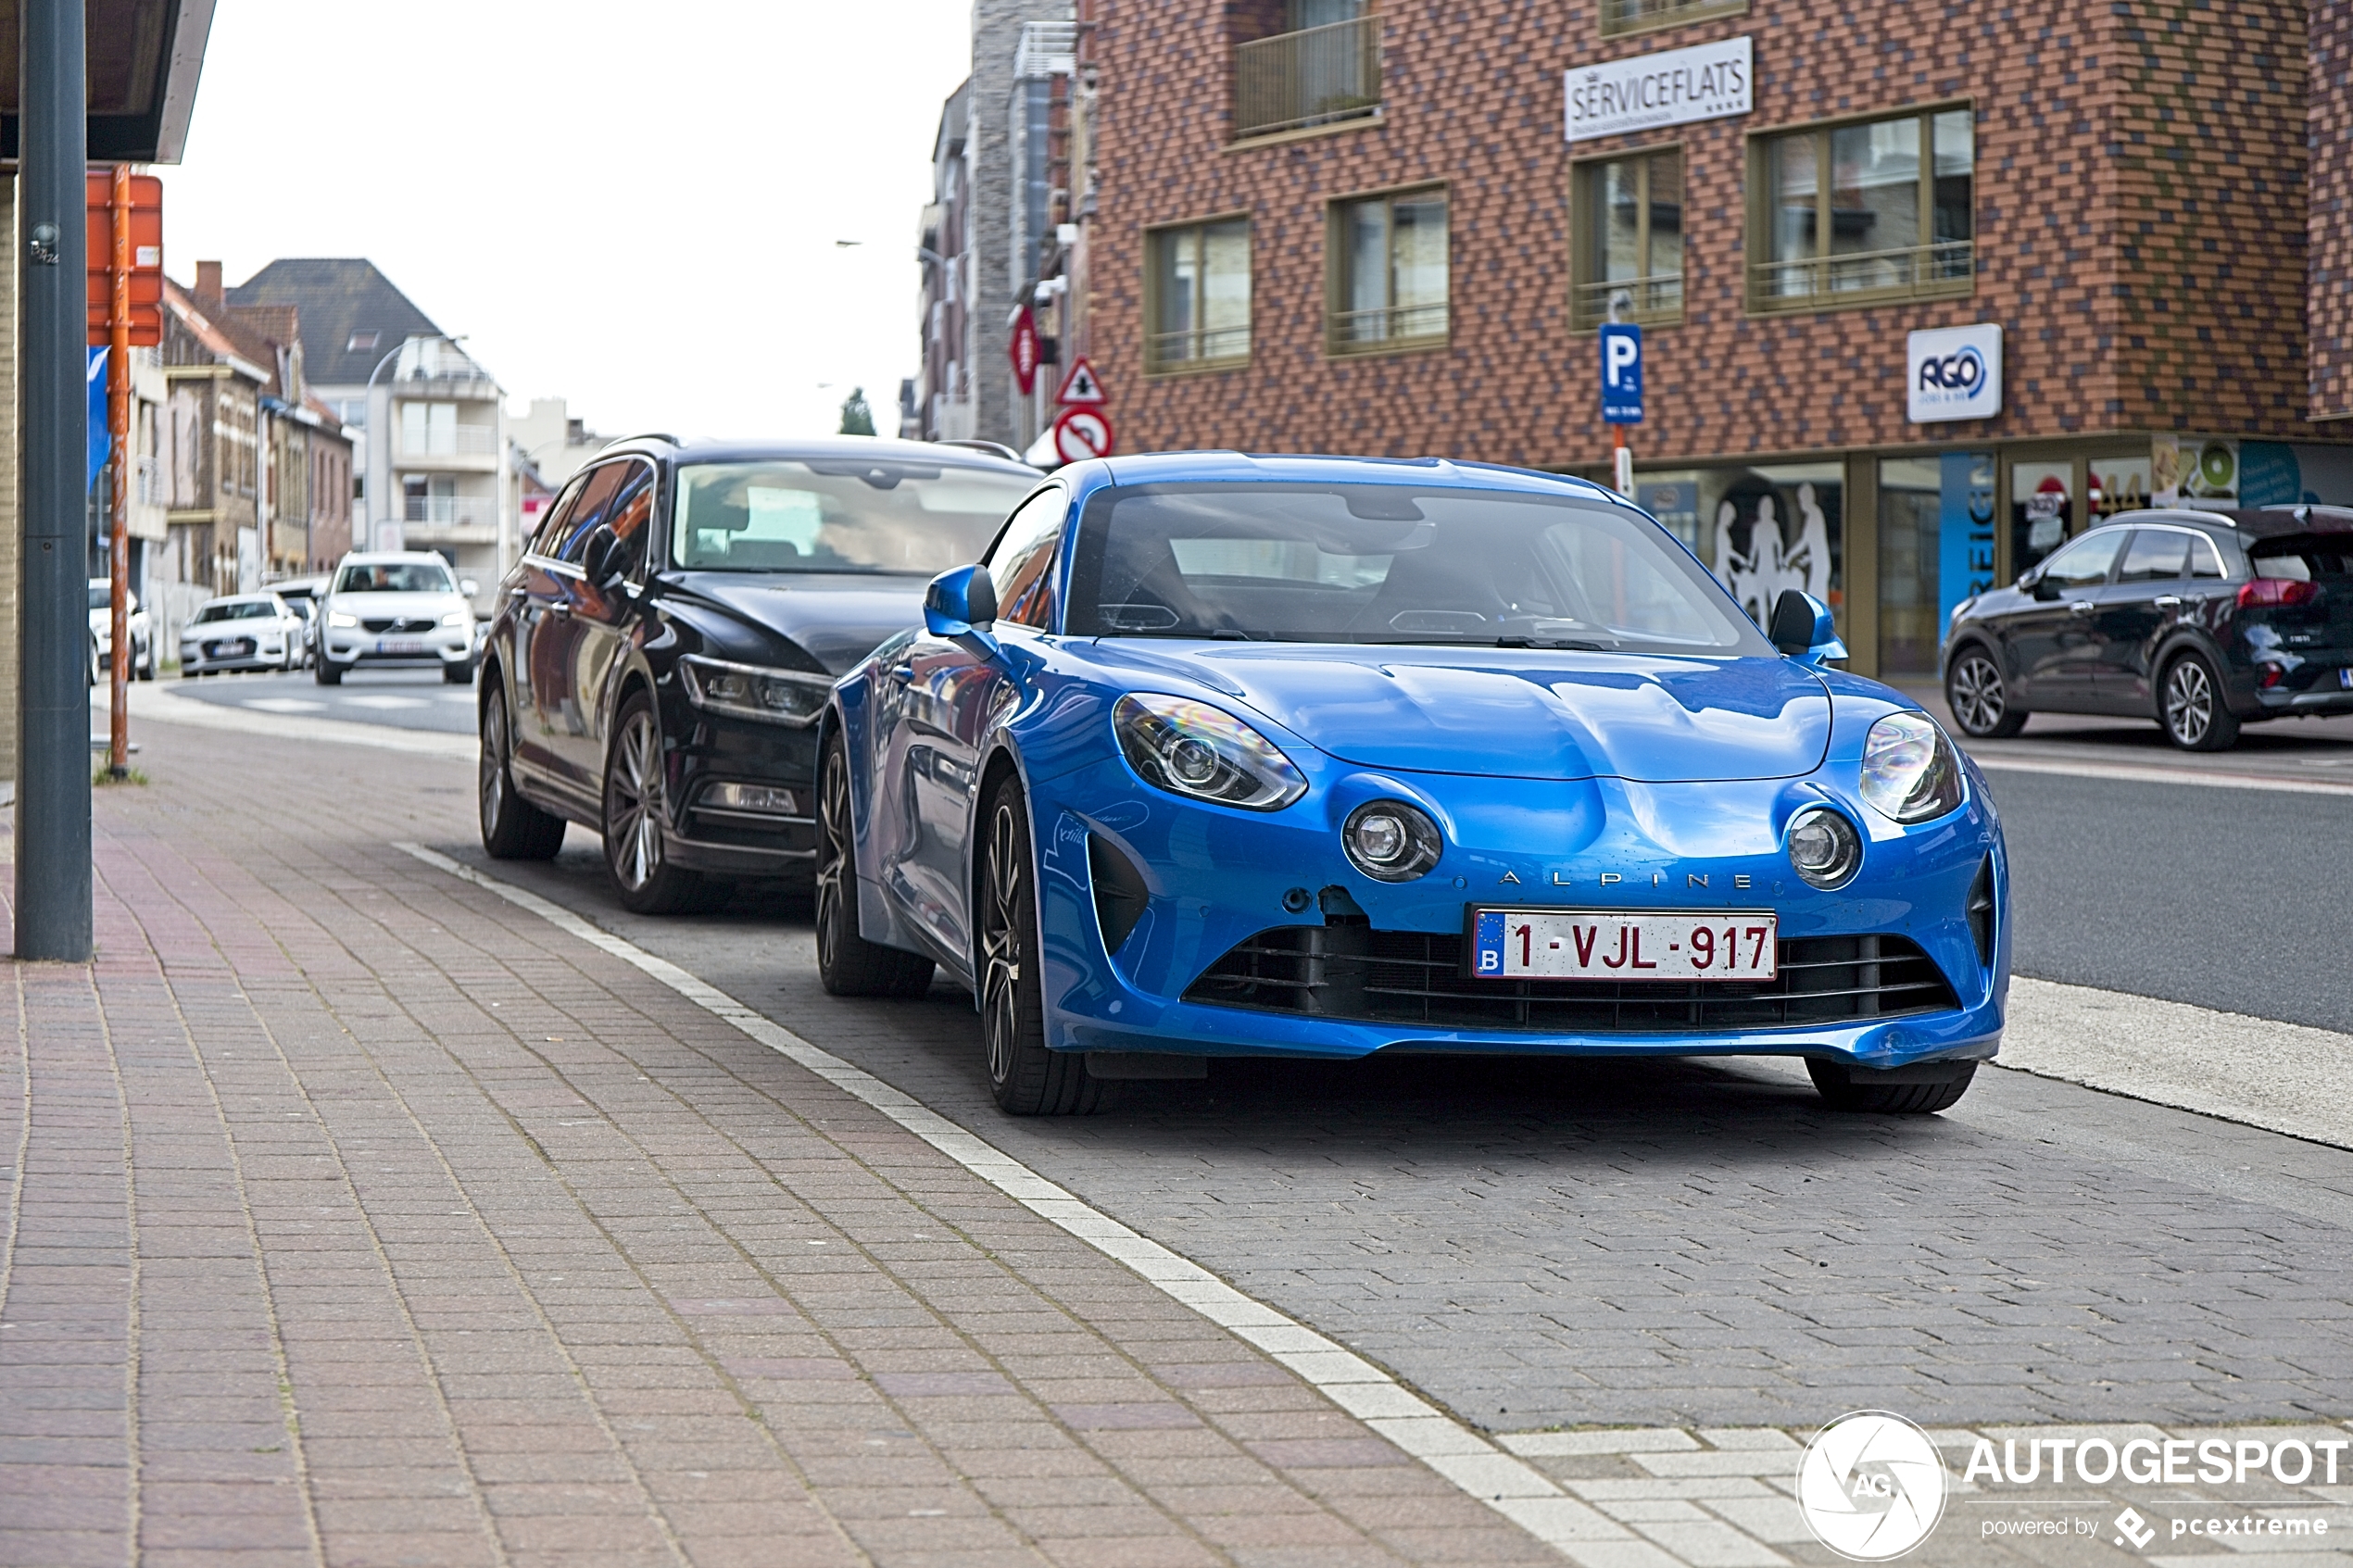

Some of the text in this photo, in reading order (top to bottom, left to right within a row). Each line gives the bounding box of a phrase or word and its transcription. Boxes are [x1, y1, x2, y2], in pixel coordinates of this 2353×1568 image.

[1572, 58, 1745, 120] SERVICEFLATS
[1606, 334, 1638, 388] P
[2098, 473, 2144, 513] 44
[1499, 871, 1752, 888] ALPINE
[1481, 949, 1499, 971] B
[1515, 923, 1768, 970] 1-VJL-917
